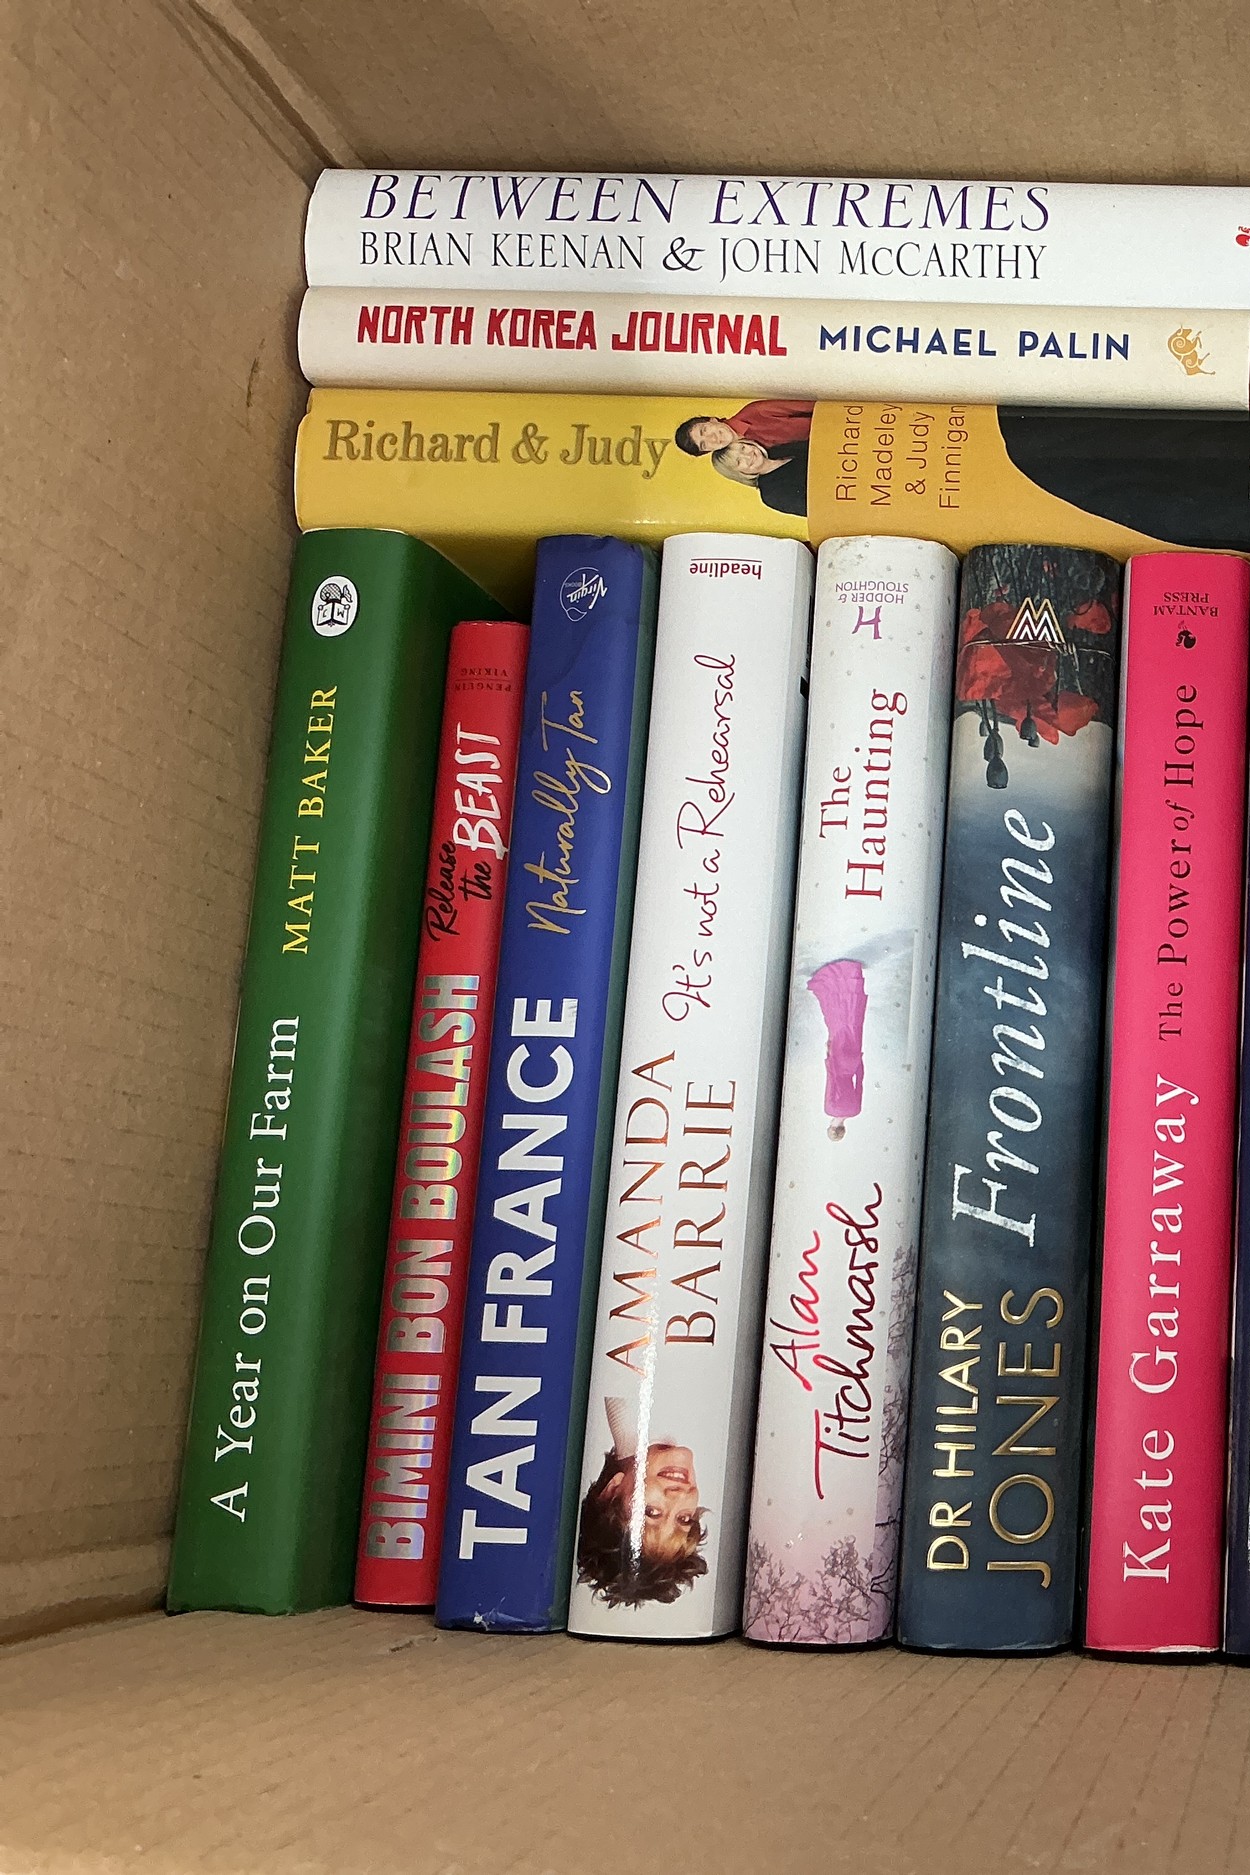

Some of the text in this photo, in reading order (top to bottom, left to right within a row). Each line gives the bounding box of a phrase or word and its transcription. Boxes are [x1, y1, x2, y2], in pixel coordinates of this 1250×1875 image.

[360, 230, 474, 267] BRIAN
[491, 233, 645, 270] KEENAN
[662, 235, 706, 271] &
[719, 237, 820, 283] JOHN
[361, 173, 1051, 231] BETWEEN EXTREMES
[357, 305, 1130, 361] NORTH KOREA JOURNAL MICHAEL PALIN
[323, 419, 672, 481] Richard & Judy
[836, 405, 863, 501] Richard
[870, 403, 903, 506] Madeley
[905, 412, 935, 495] & Judy
[939, 405, 969, 508] Finnigan
[689, 561, 763, 579] headline
[835, 581, 909, 593] STOUGHTON
[838, 593, 904, 604] HODDER &
[1154, 605, 1218, 617] BANTAM
[1164, 592, 1209, 603] PRESS
[461, 668, 508, 677] VIKING
[282, 685, 339, 955] MATT BAKER
[452, 723, 509, 861] BEAST
[526, 690, 611, 935] Naturally Tan
[661, 654, 735, 1022] It's not a Rehearsal
[819, 766, 852, 838] The
[845, 688, 907, 901] Haunting
[427, 840, 458, 942] Release
[458, 861, 493, 902] the
[1156, 683, 1204, 1041] The Power of Hope
[951, 808, 1056, 1248] Frontline
[210, 1015, 300, 1523] A Year on Our Farm
[366, 975, 480, 1560] BIMINI BON BOULASH
[606, 1050, 676, 1377] AMANDA
[665, 1081, 737, 1346] BARRIE
[457, 997, 577, 1560] TAN FRANCE
[769, 1230, 821, 1392] Alan
[1122, 1072, 1200, 1585] Kate Garraway
[813, 1182, 882, 1500] Titchmarsh
[926, 1289, 983, 1572] DR HILARY
[986, 1286, 1065, 1590] JONES
